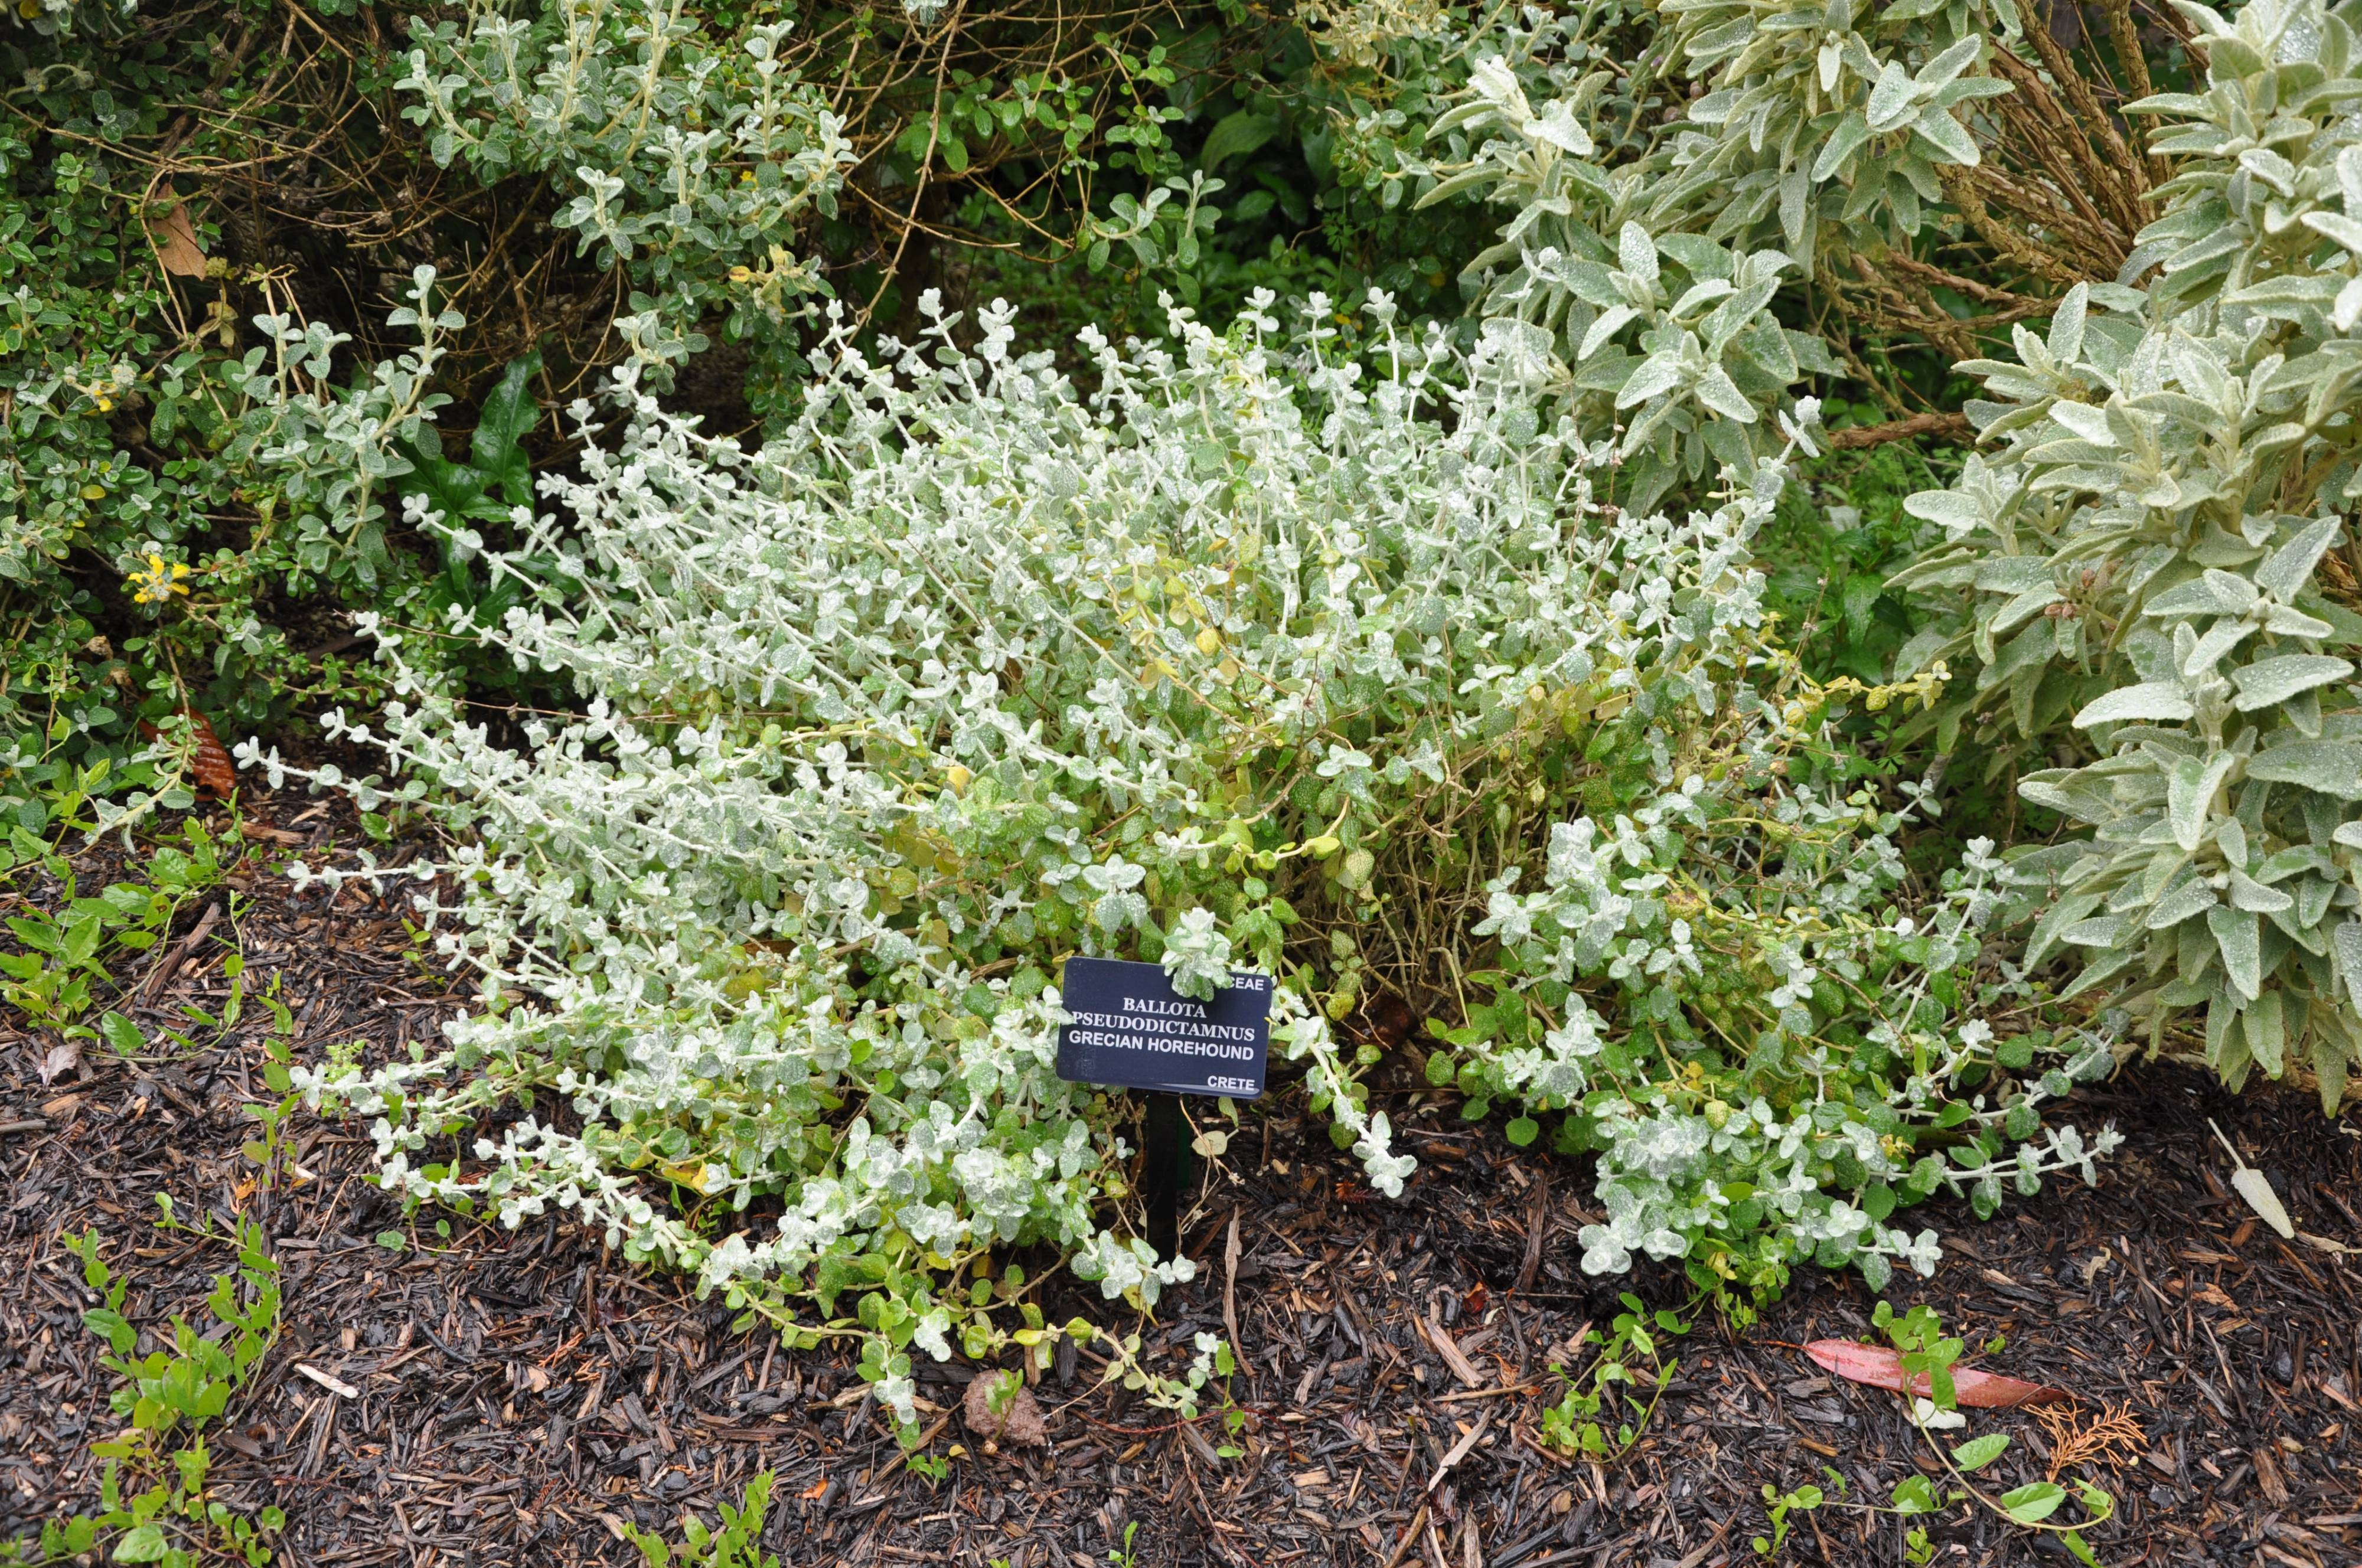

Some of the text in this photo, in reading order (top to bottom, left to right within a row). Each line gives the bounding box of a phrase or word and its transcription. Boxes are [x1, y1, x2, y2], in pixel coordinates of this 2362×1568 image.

[1123, 998, 1206, 1018] BALLOTA
[1072, 1011, 1255, 1041] PSEUDODICTAMNUS
[1069, 1030, 1254, 1060] GRECIAN HOREHOUND
[1208, 1076, 1255, 1090] CRETE
